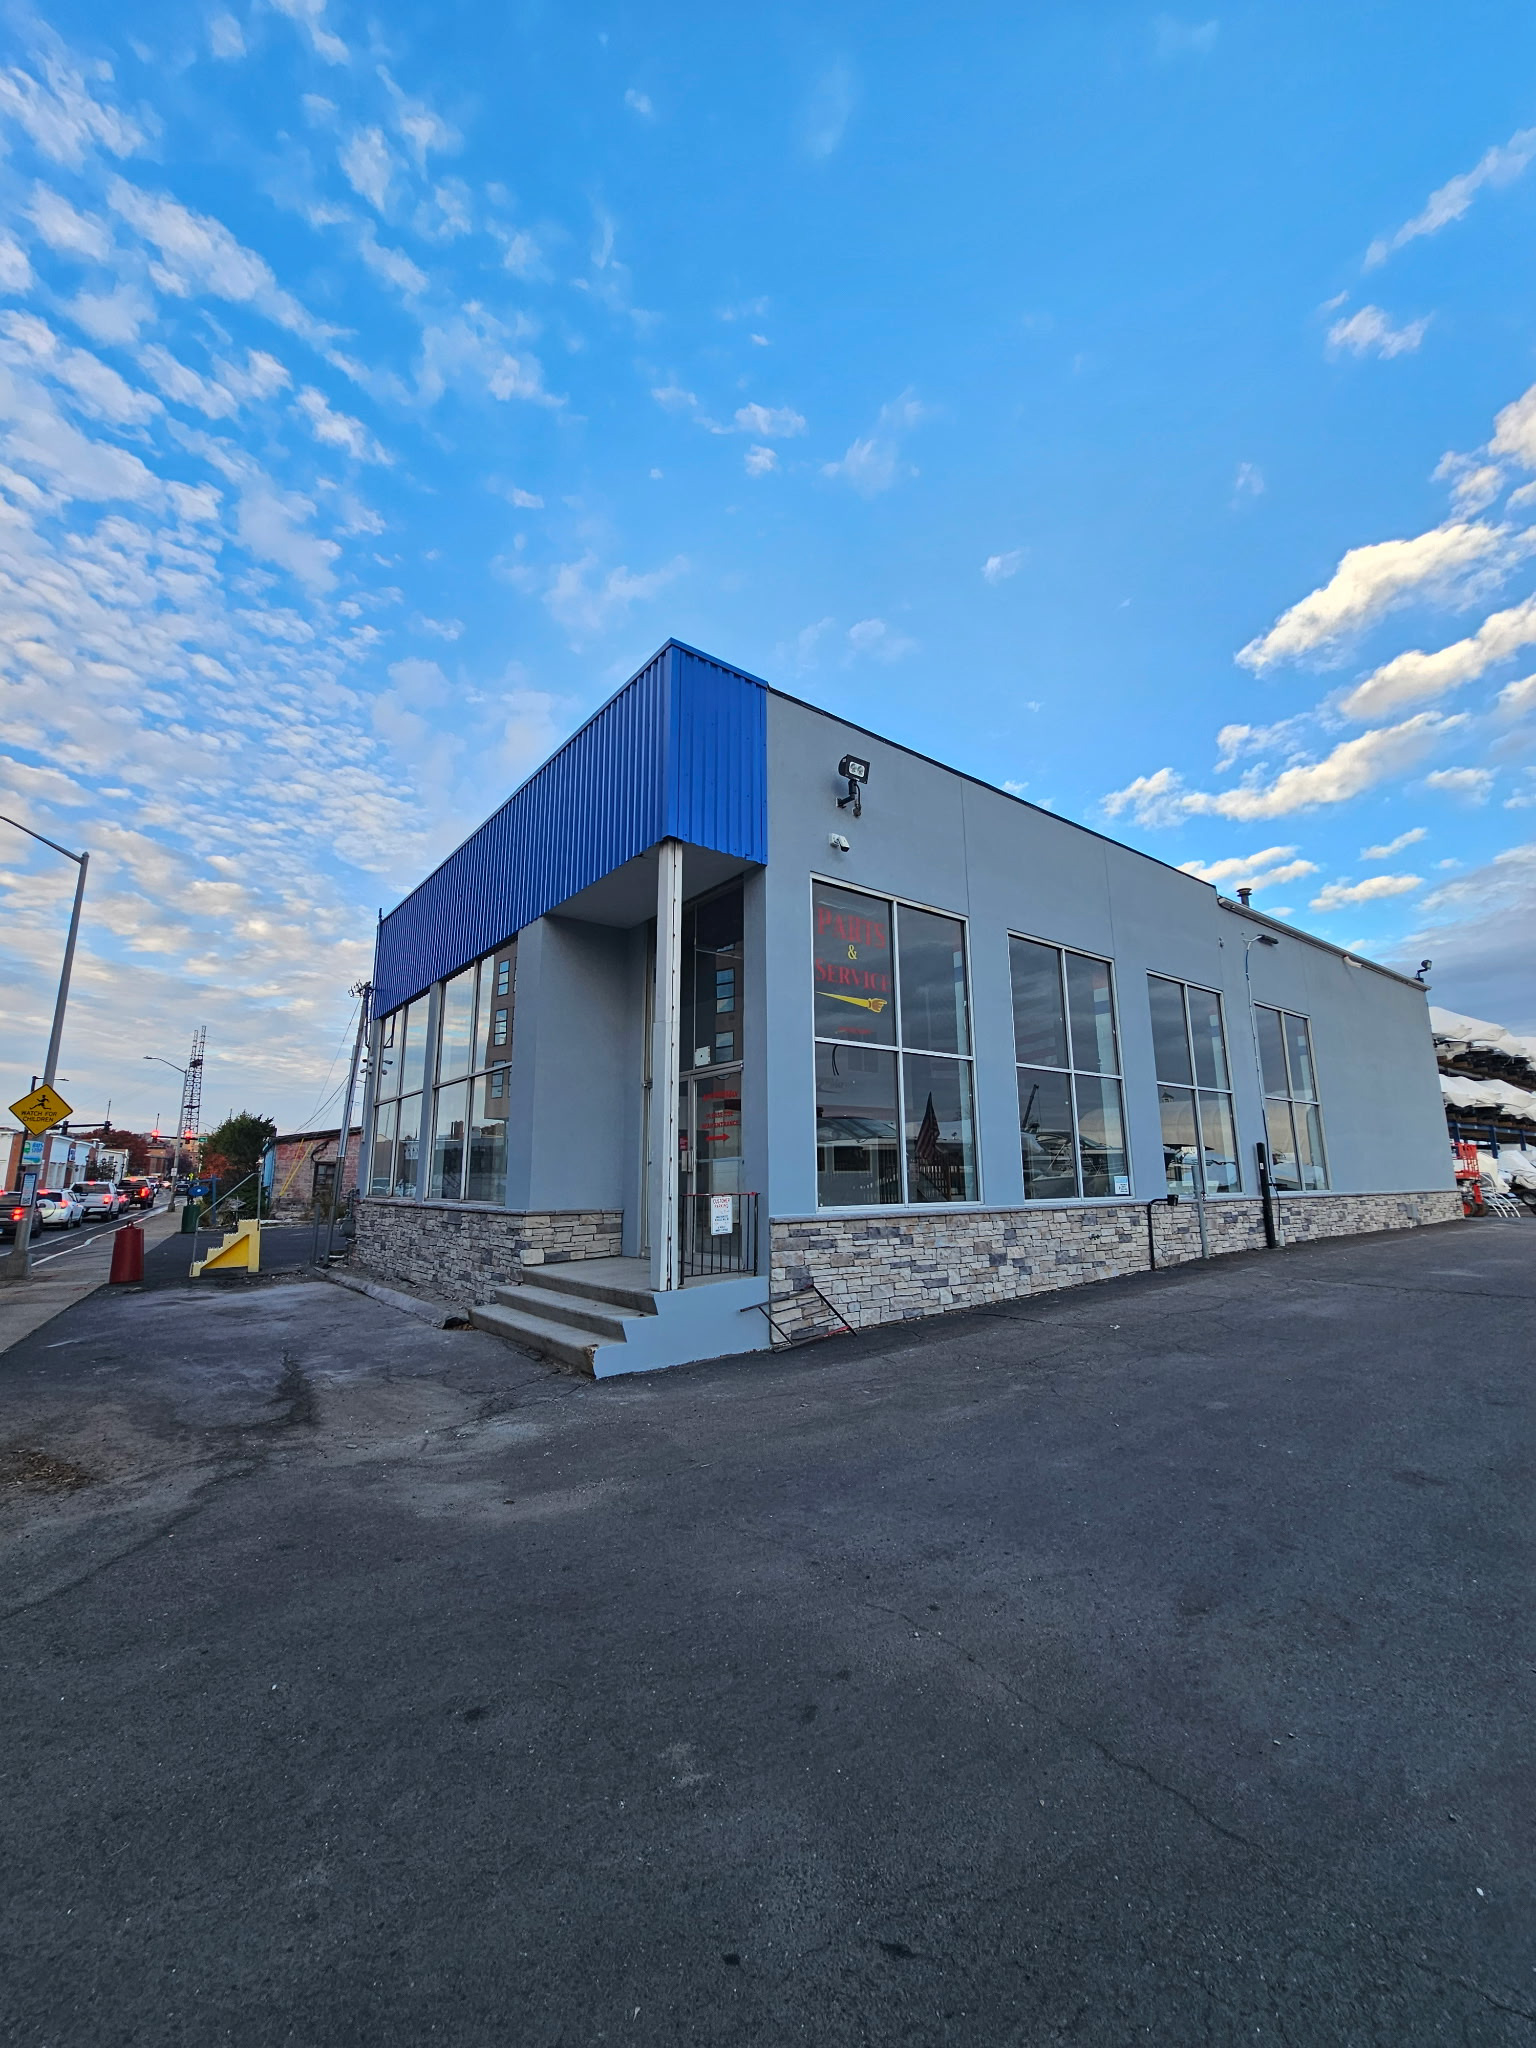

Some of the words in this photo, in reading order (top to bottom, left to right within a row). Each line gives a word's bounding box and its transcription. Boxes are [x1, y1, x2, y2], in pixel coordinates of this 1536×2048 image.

[817, 907, 887, 949] PARTS
[847, 944, 858, 960] &
[815, 957, 892, 993] SERVICE
